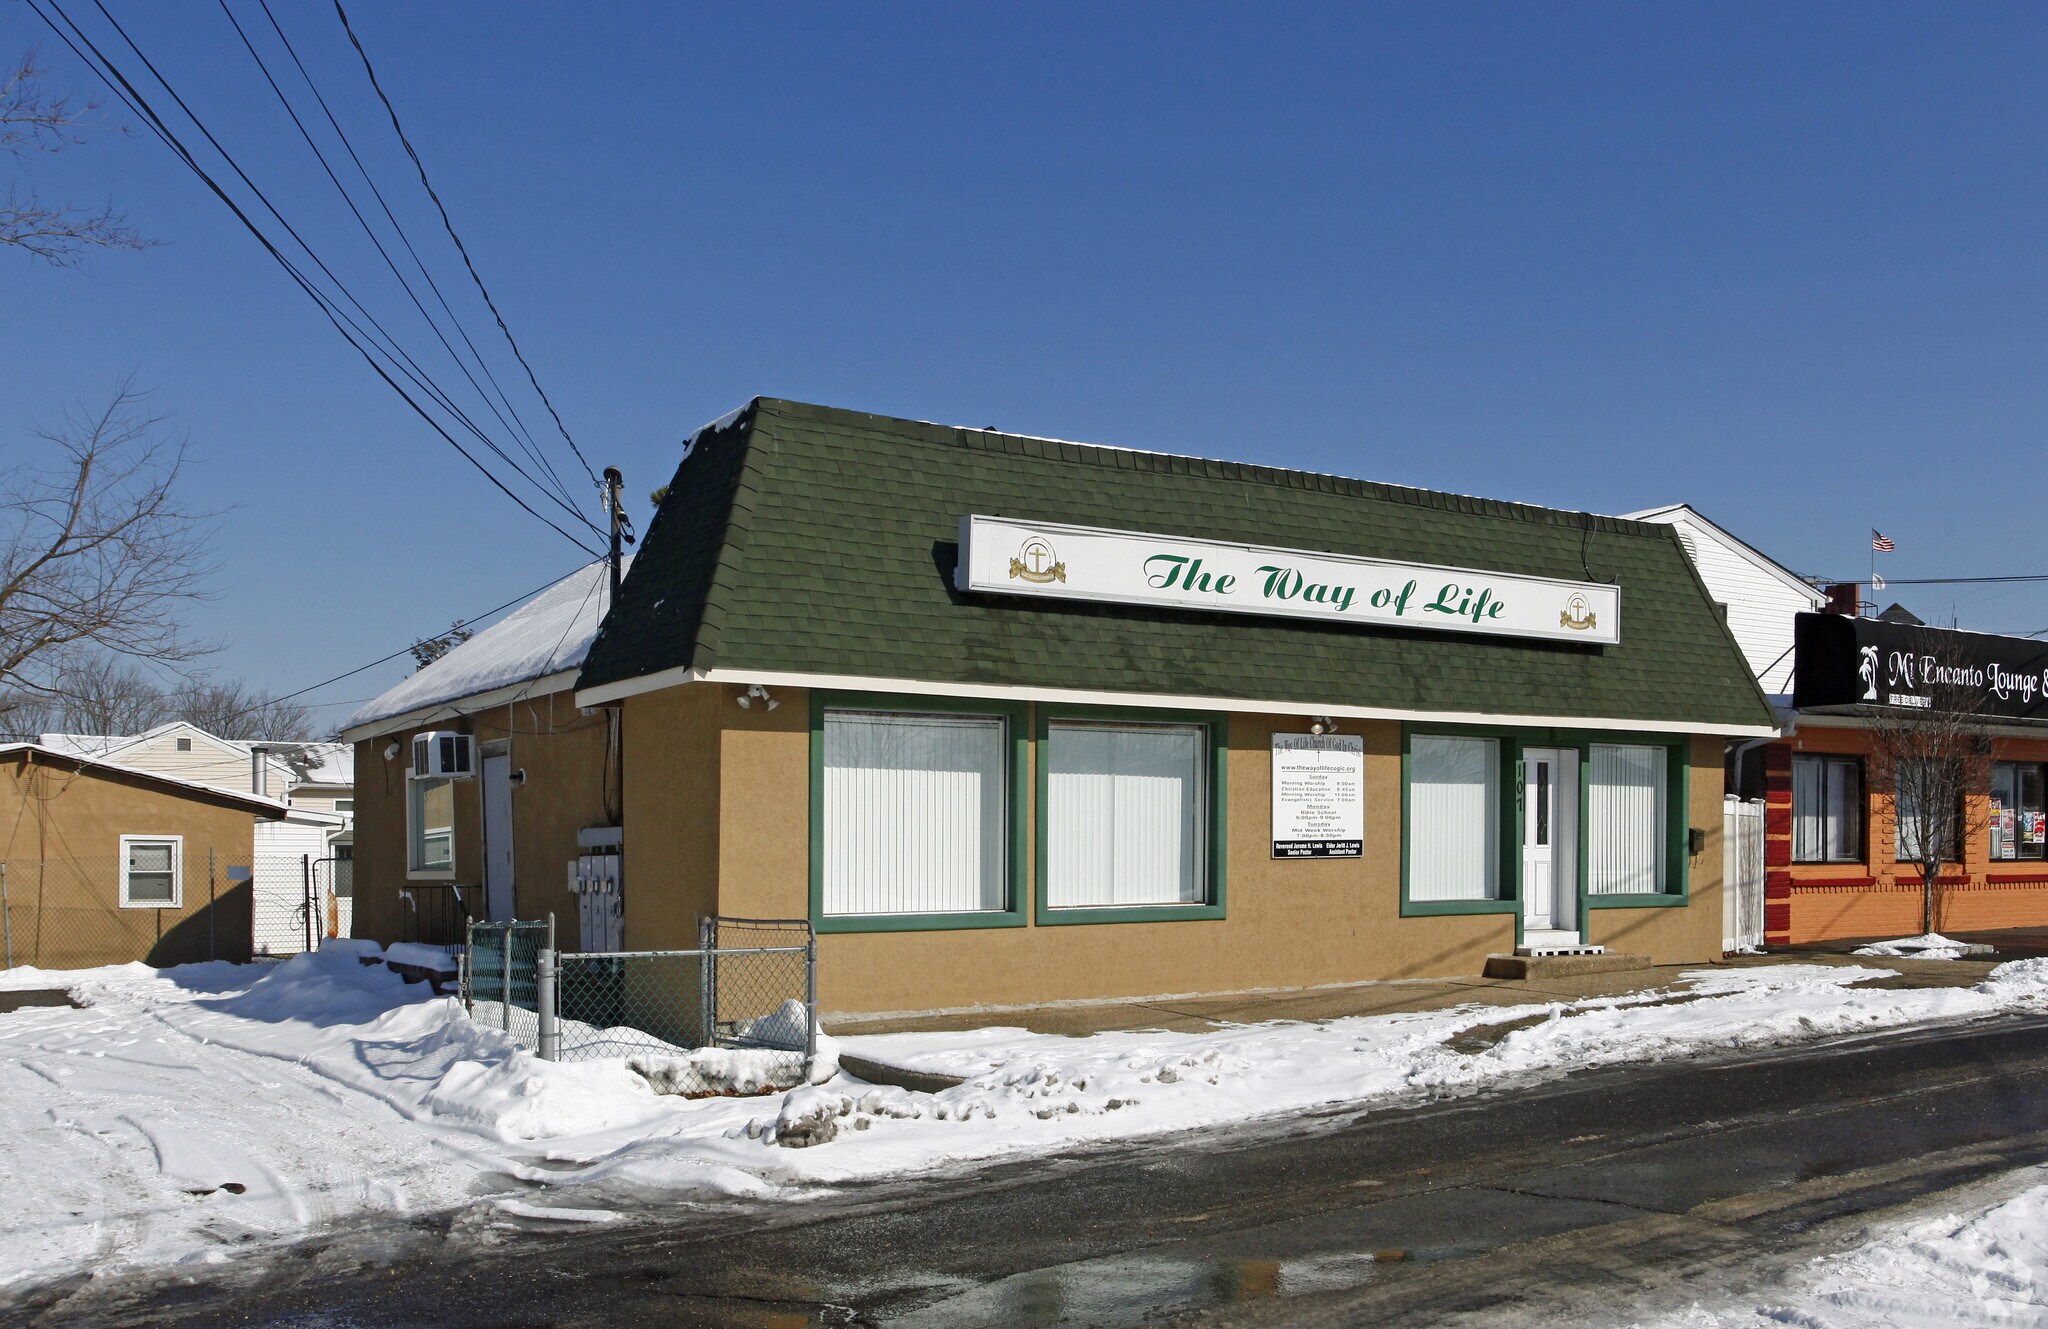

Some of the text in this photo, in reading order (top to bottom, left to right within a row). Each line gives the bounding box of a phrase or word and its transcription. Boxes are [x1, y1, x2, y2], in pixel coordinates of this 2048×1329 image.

[1143, 554, 1506, 623] The Way of Life
[1888, 651, 1914, 689] Mi
[1919, 655, 1983, 687] Encanto
[1987, 663, 2038, 703] Lounge
[1300, 736, 1309, 750] Life
[1310, 736, 1326, 750] Church
[1333, 737, 1342, 751] God
